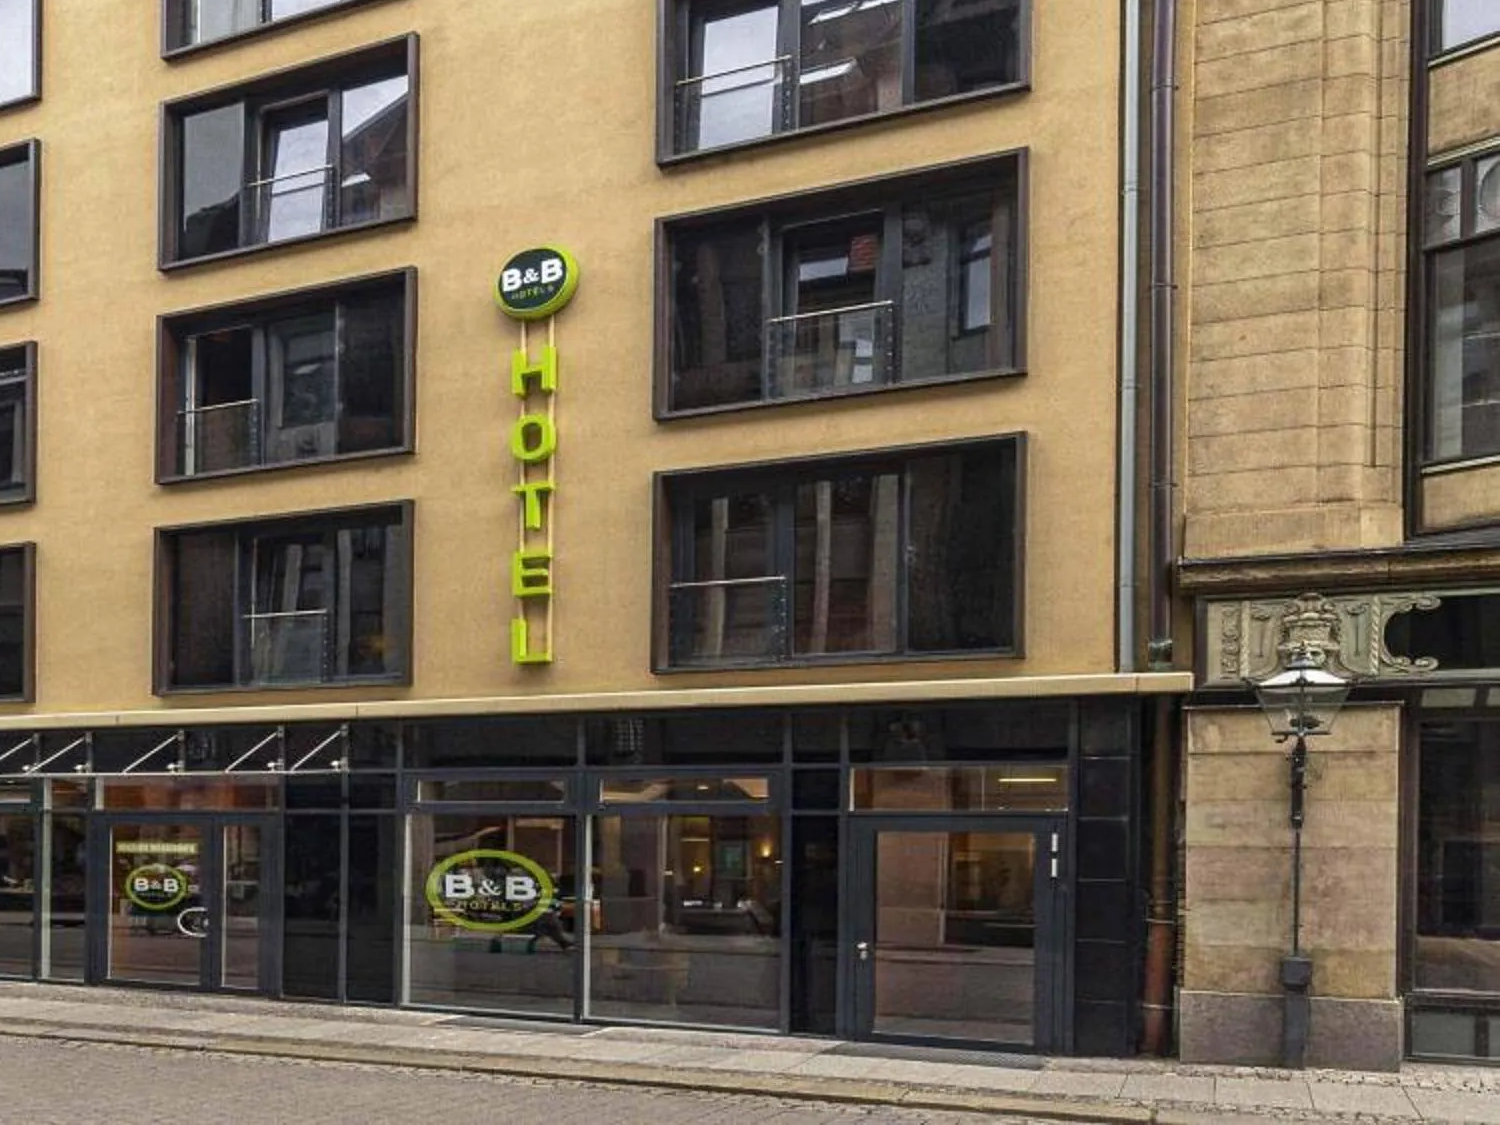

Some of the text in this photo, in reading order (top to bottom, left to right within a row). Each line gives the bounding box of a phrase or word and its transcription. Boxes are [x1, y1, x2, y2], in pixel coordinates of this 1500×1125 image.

[502, 258, 563, 292] B&B
[511, 346, 557, 665] HOTEL
[134, 877, 179, 893] B&B
[445, 874, 537, 900] B&B
